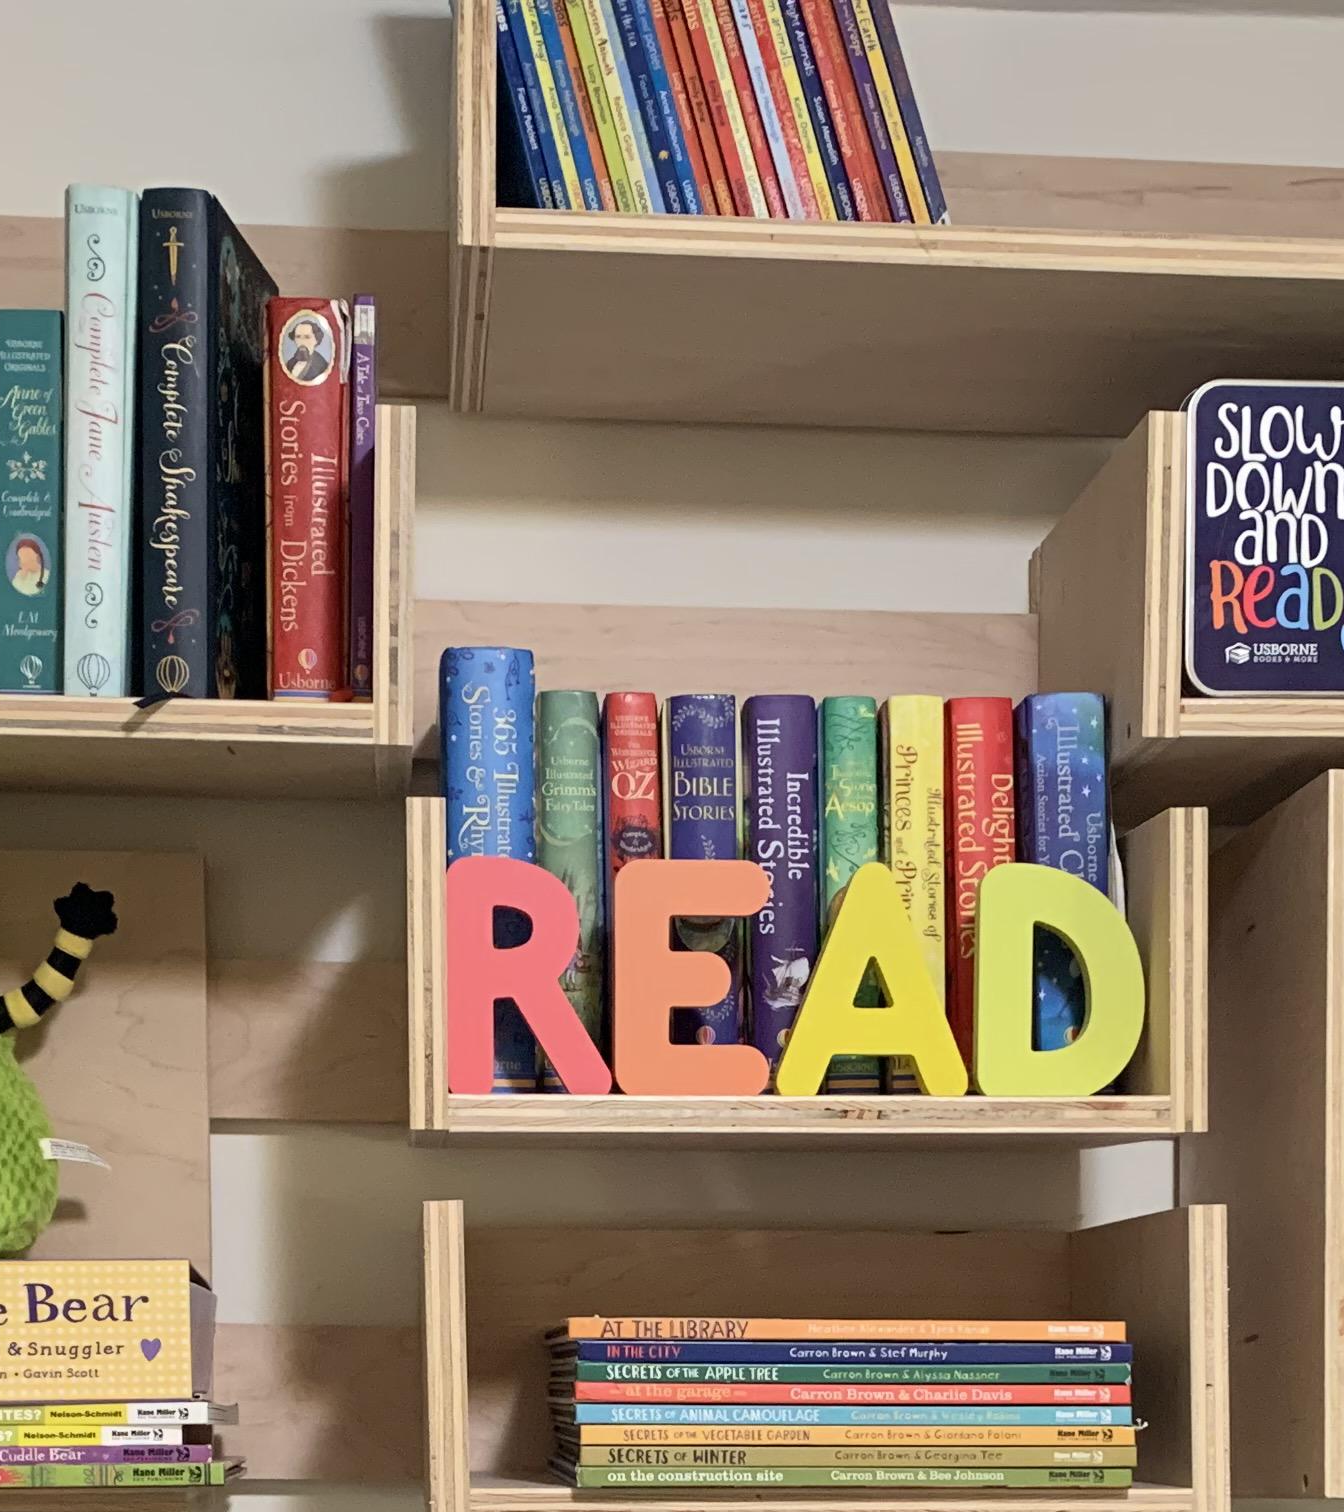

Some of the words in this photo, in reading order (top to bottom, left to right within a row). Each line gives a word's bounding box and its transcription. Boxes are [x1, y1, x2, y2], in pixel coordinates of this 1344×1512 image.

[75, 292, 118, 396] Complete
[157, 336, 196, 448] Complete
[77, 401, 118, 462] Jane
[79, 465, 118, 572] Austen
[311, 448, 339, 577] Illustrated
[150, 449, 195, 610] Shakespeare
[280, 539, 308, 632] Dickens
[1254, 644, 1318, 656] USBORNE
[674, 775, 733, 799] BIBLE
[673, 802, 735, 821] STORIES
[446, 856, 1146, 1096] READ
[25, 1283, 149, 1323] Bear
[601, 1320, 622, 1337] AT
[632, 1320, 663, 1338] THE
[671, 1320, 747, 1339] LIBRARY
[8, 1342, 22, 1356] &
[27, 1341, 125, 1360] Snuggler
[790, 1347, 828, 1359] Carron
[831, 1347, 864, 1359] Brown
[869, 1347, 877, 1359] &
[880, 1347, 905, 1358] Stef
[908, 1347, 947, 1361] Murphy
[23, 1368, 61, 1379] Gavin
[67, 1368, 99, 1379] Scott
[606, 1366, 662, 1381] SECRETS
[666, 1368, 679, 1380] OF
[682, 1368, 699, 1378] THE
[704, 1366, 745, 1381] APPLE
[750, 1366, 778, 1380] TREE
[608, 1447, 669, 1464] SECRETS
[674, 1451, 686, 1462] OF
[693, 1448, 747, 1464] WINTER
[608, 1472, 626, 1482] on
[631, 1469, 654, 1482] the
[658, 1468, 750, 1482] construction
[754, 1469, 783, 1482] site
